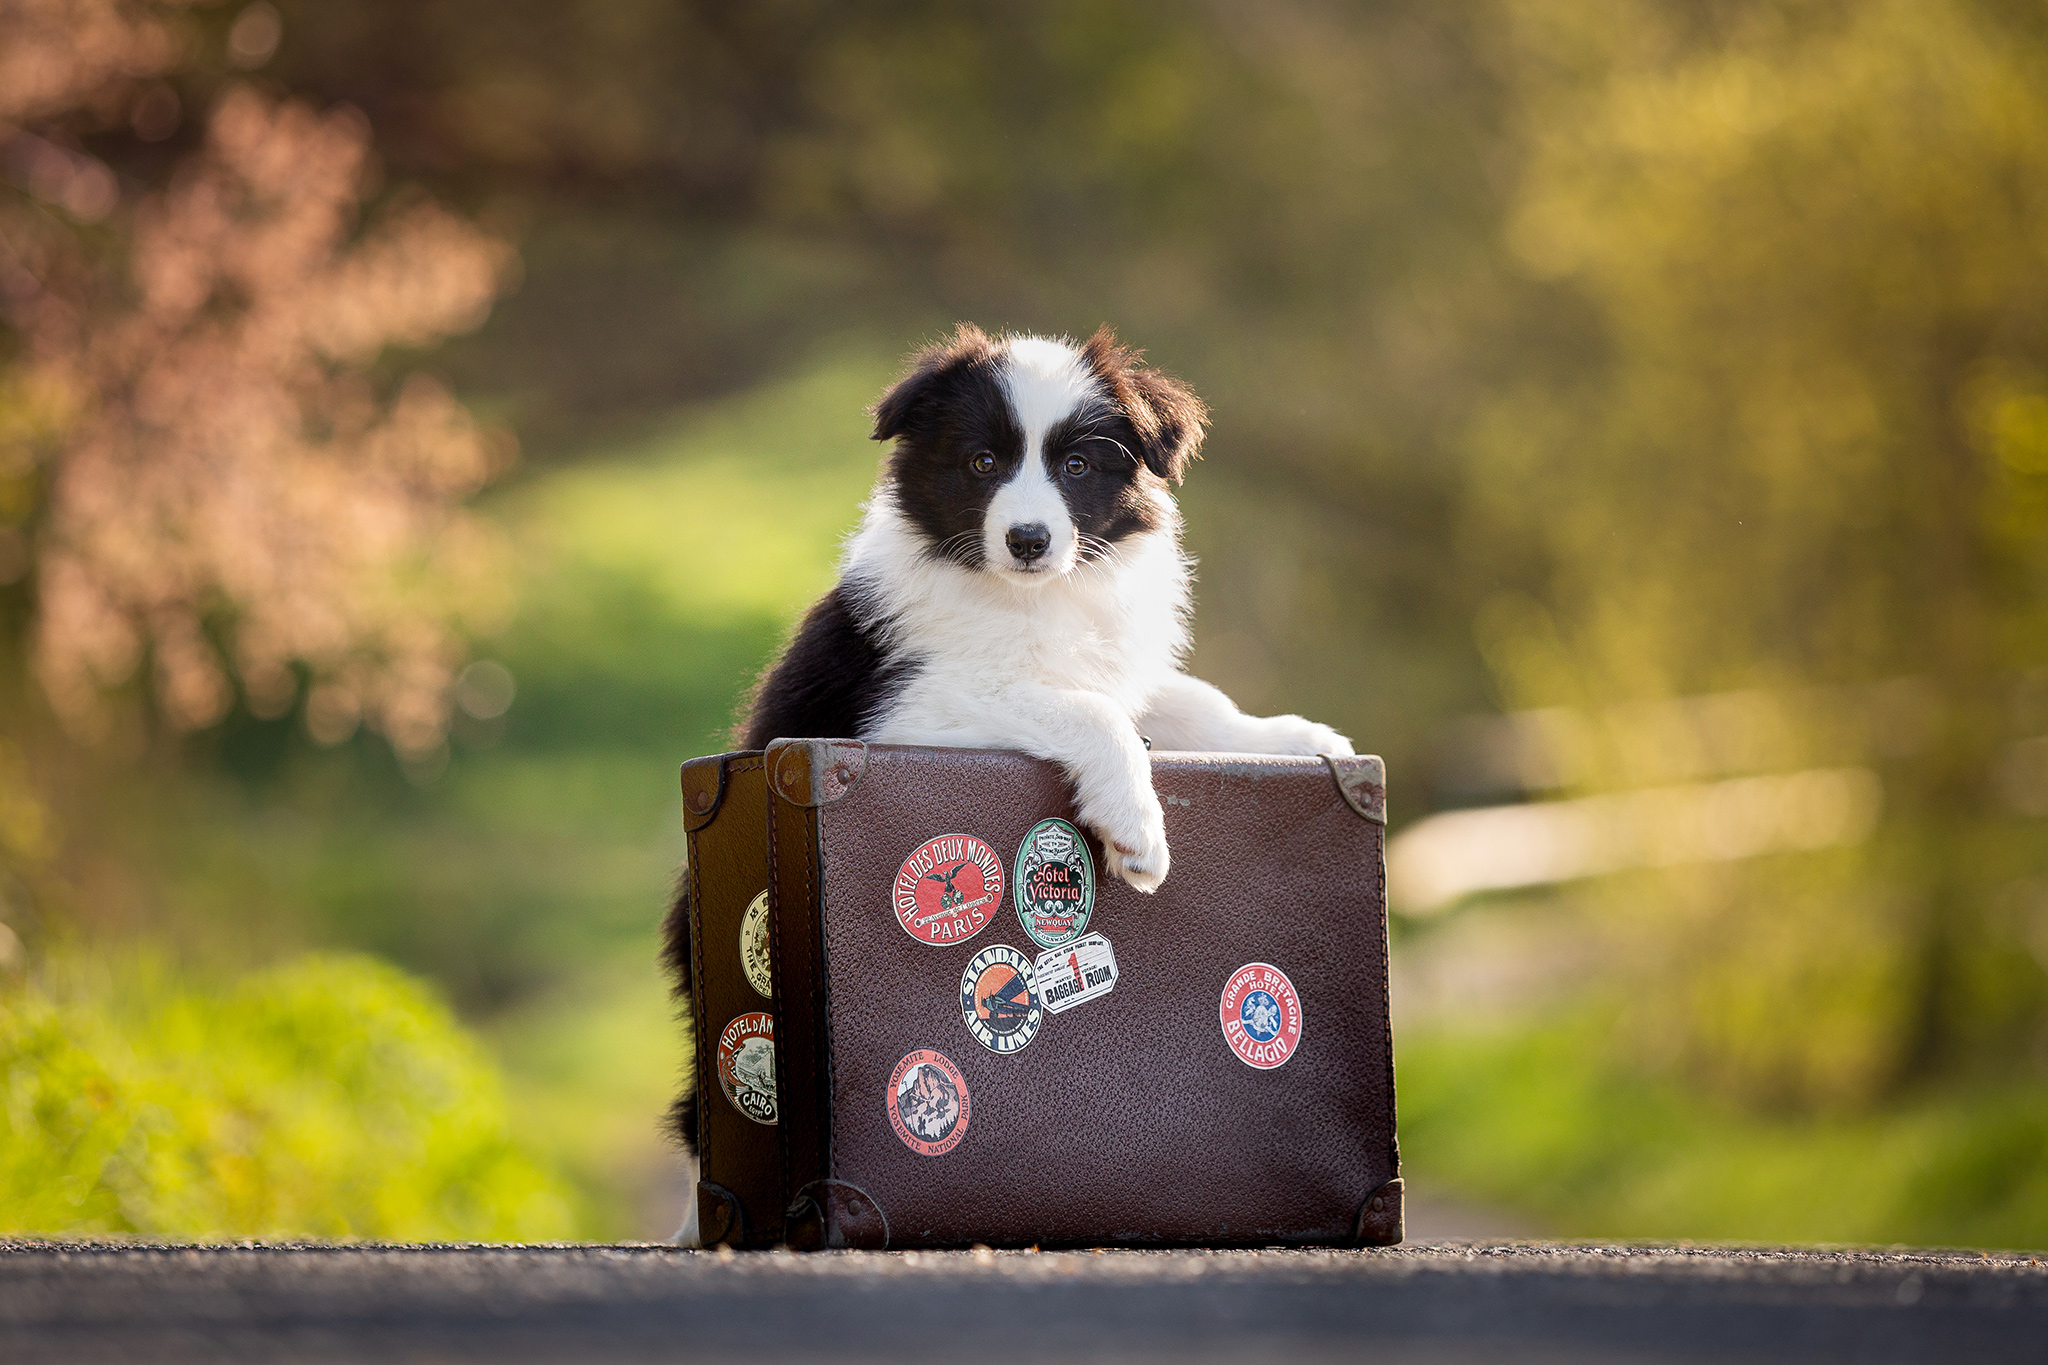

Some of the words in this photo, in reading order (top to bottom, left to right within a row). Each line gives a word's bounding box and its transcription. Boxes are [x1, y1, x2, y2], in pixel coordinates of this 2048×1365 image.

[908, 849, 934, 878] DES
[932, 838, 964, 865] DEUX
[966, 840, 1001, 893] MONDES
[1028, 882, 1080, 903] Victoria
[930, 908, 985, 939] PARIS
[1036, 919, 1072, 928] NEWQUAY
[746, 946, 757, 972] THE
[964, 948, 1037, 996] STANDARD
[1068, 952, 1084, 992] 1
[1045, 977, 1084, 1005] BAGGAGE
[1085, 965, 1112, 988] ROOM
[1226, 970, 1256, 1009] GRANDE
[1264, 972, 1297, 1035] BRETAGNE
[722, 1018, 752, 1050] HOTEL
[964, 1010, 993, 1046] AIR
[998, 1009, 1039, 1050] LINES
[1226, 1019, 1288, 1062] BELLAGIO
[889, 1052, 924, 1088] YOSEMITE
[934, 1054, 959, 1079] LODGE
[742, 1092, 772, 1115] CAIRO
[889, 1104, 921, 1150] YOSEMITE
[928, 1127, 964, 1154] NATIONAL
[961, 1094, 969, 1120] PARK
